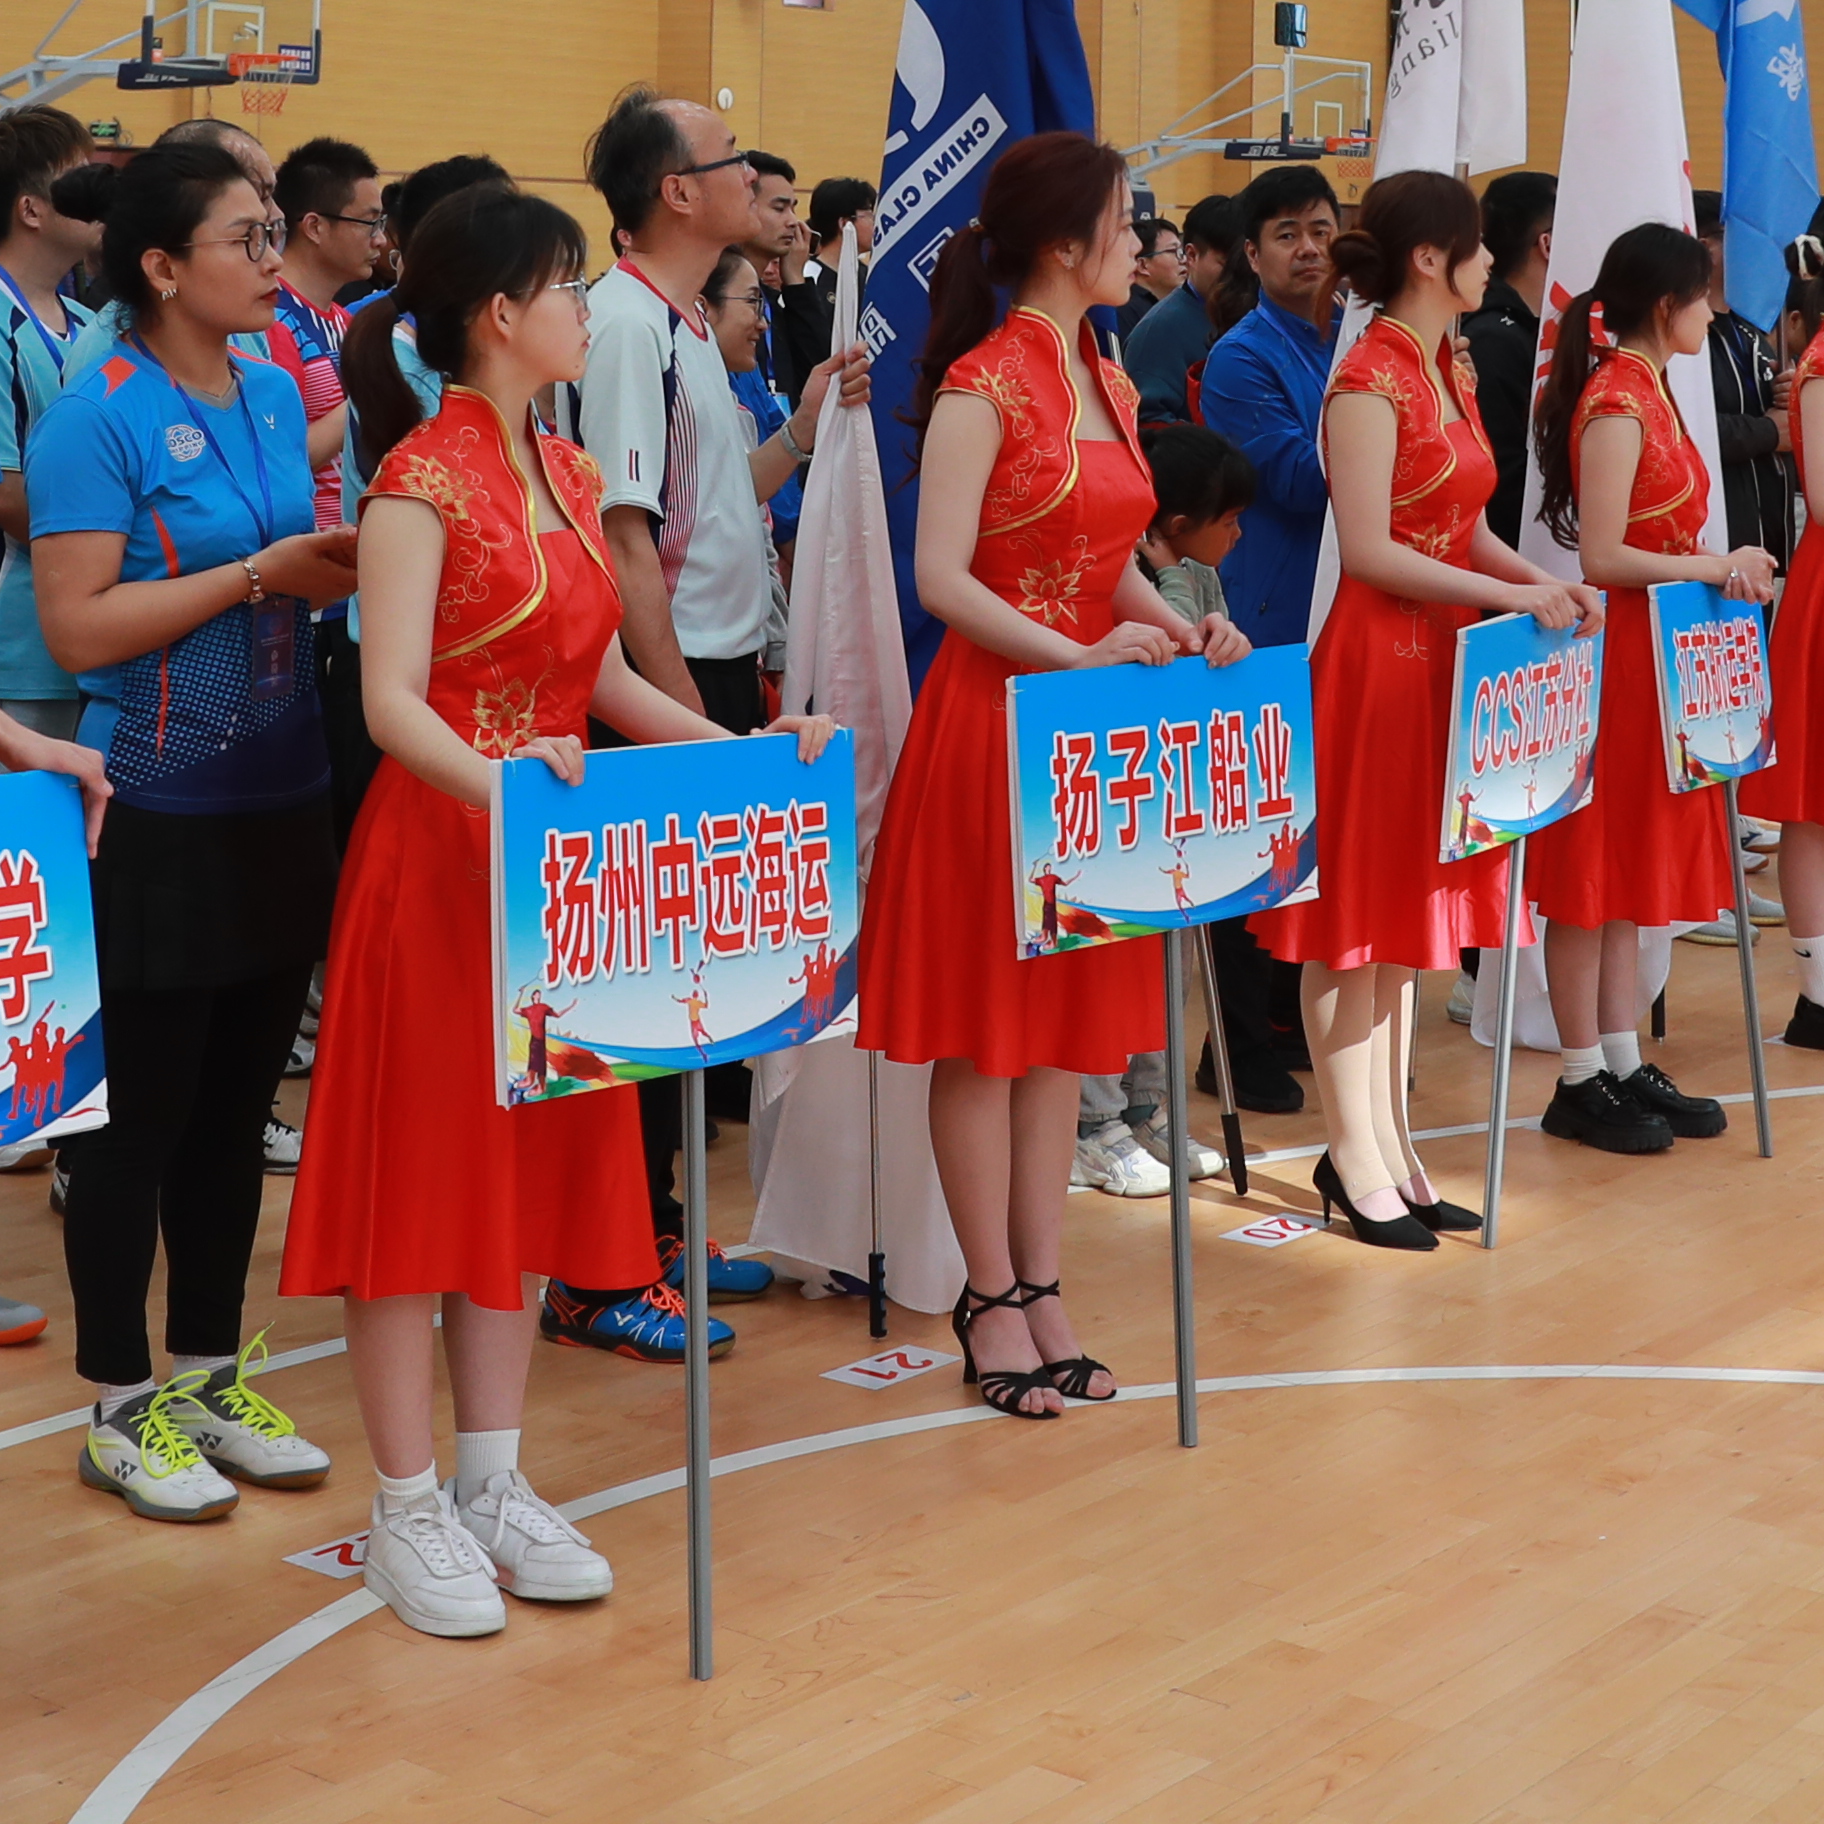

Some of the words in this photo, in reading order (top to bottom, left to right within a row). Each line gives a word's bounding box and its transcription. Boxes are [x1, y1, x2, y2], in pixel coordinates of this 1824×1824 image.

[1471, 641, 1593, 777] CCS江苏分社
[1049, 703, 1294, 860] 扬子江船业
[540, 797, 831, 987] 扬州中远海运
[1242, 1218, 1313, 1240] 20
[849, 1352, 934, 1380] 21
